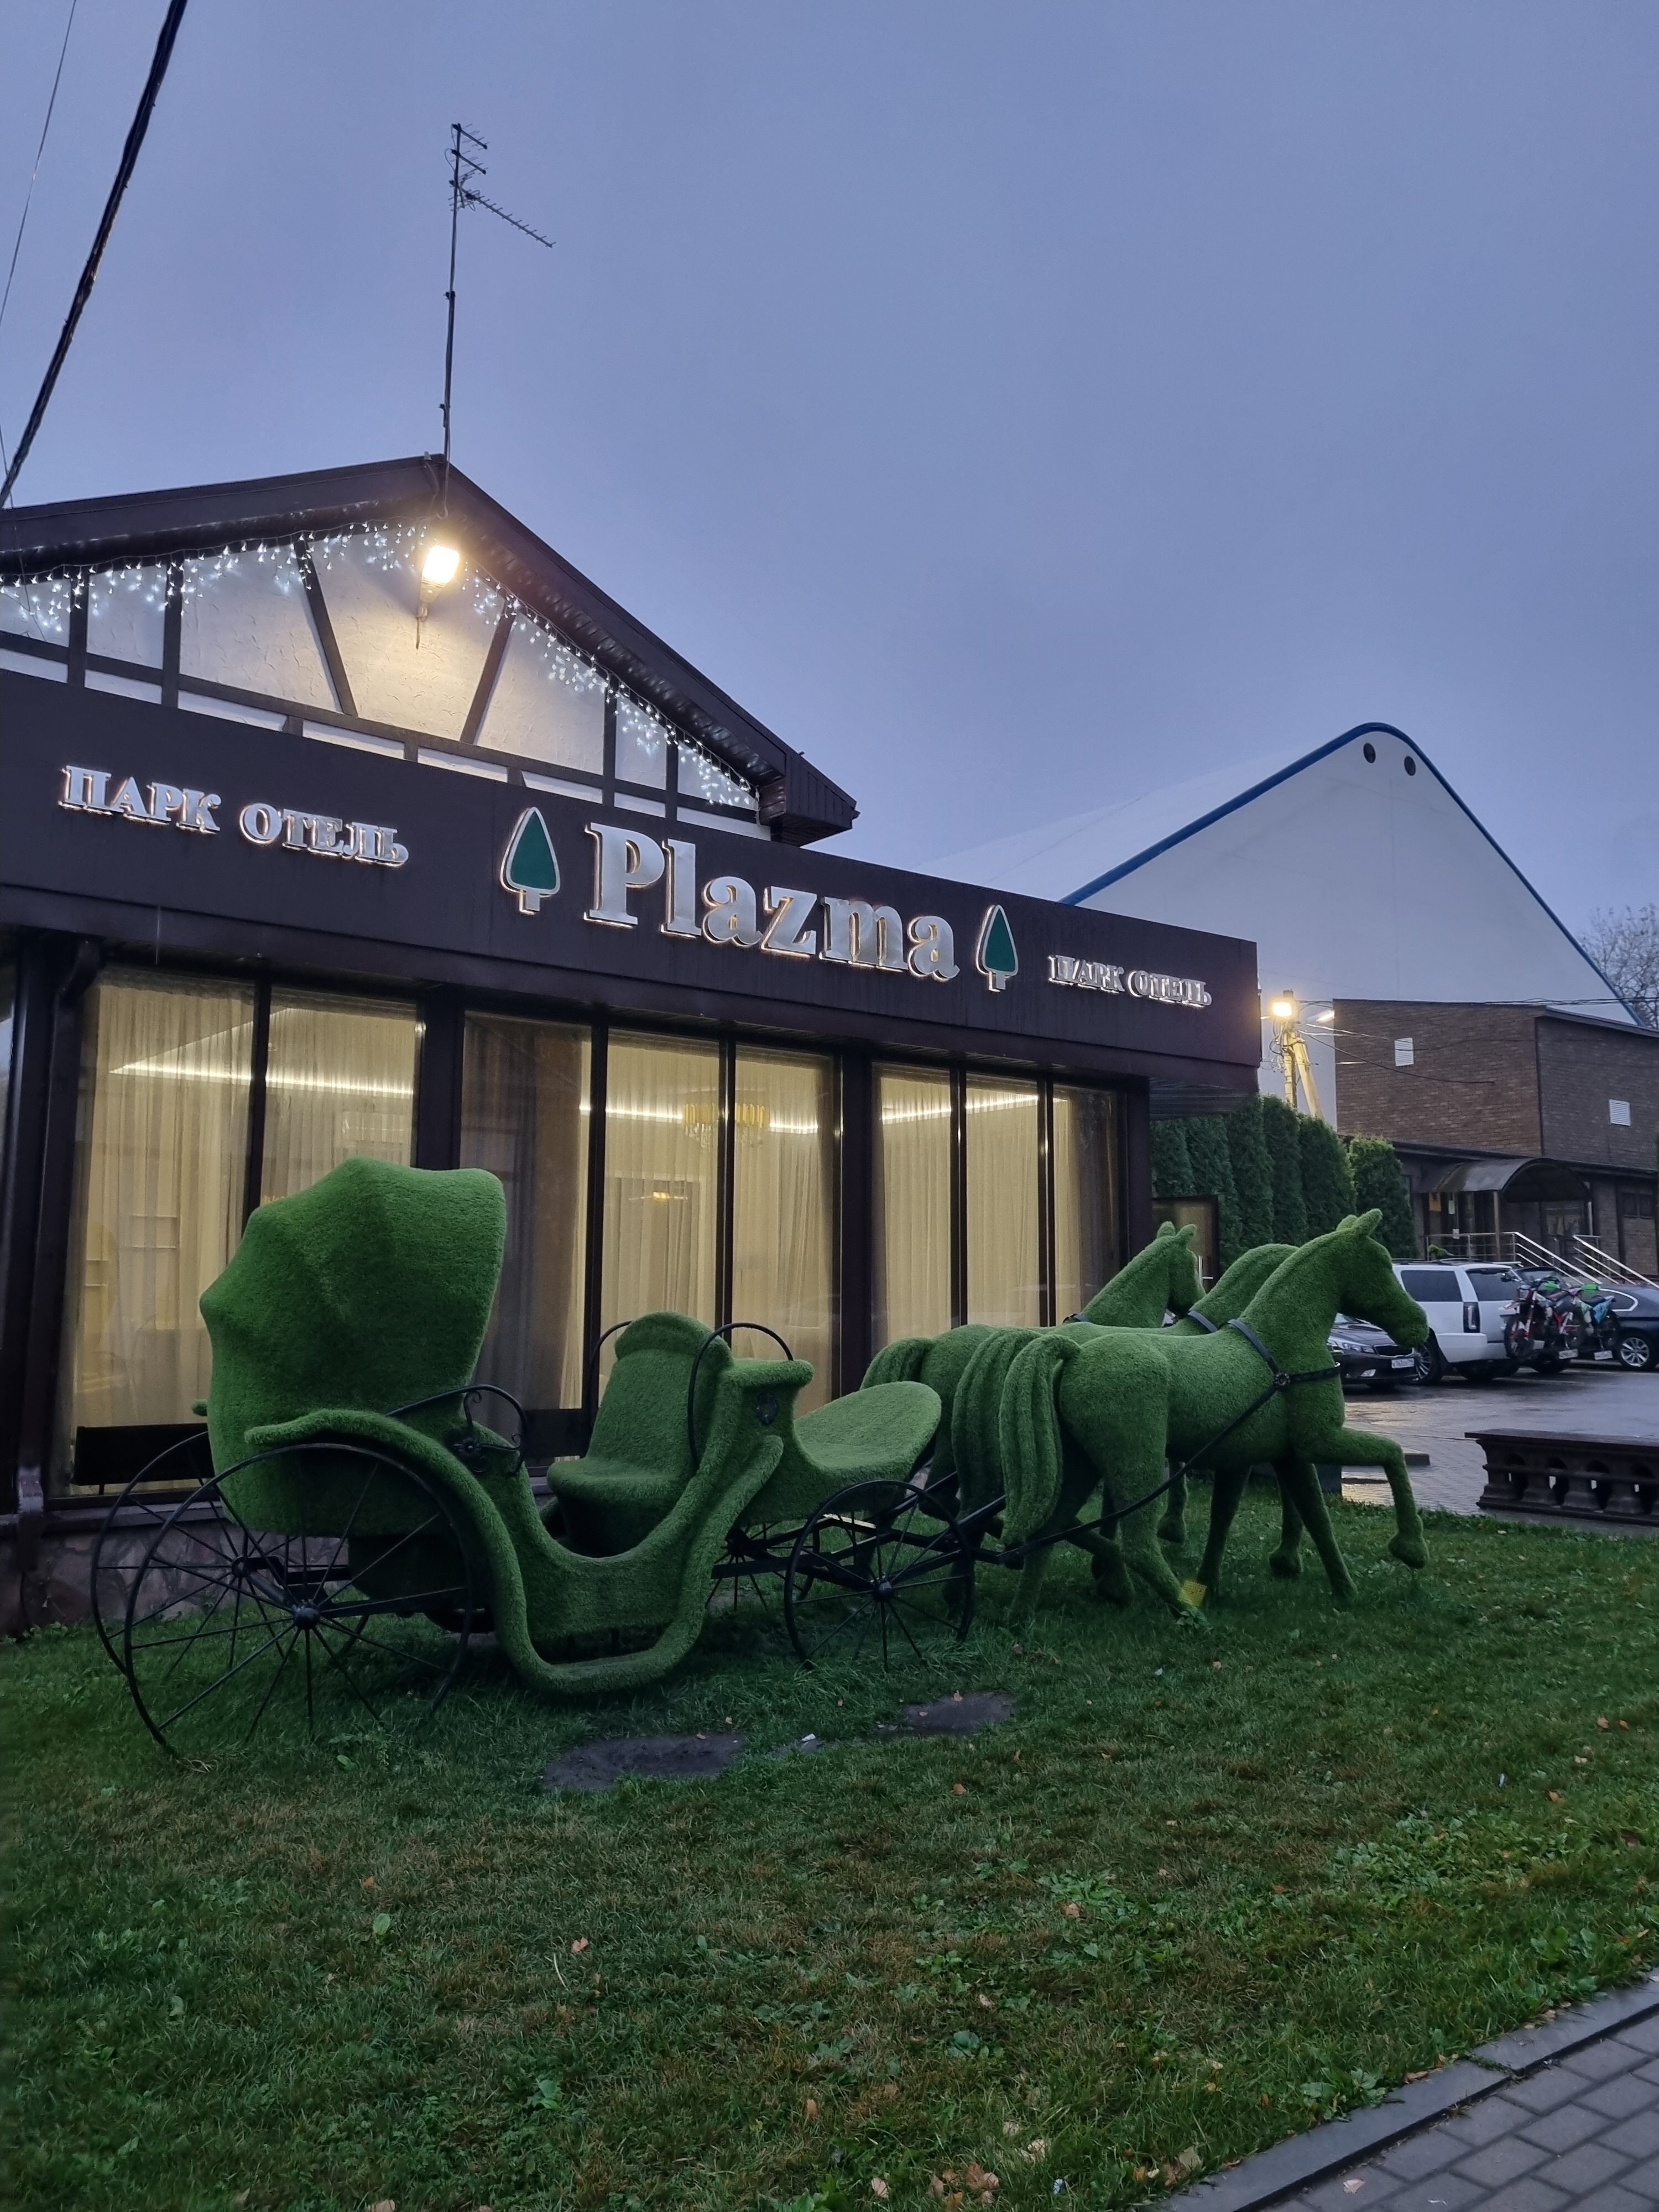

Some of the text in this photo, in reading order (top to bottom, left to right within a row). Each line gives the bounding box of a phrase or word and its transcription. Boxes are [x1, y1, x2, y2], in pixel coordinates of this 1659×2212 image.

[58, 765, 409, 867] ПАРК ОТЕЛЬ
[583, 822, 960, 982] Plazma
[1048, 954, 1213, 1008] ПАРК ОТЕЛЬ
